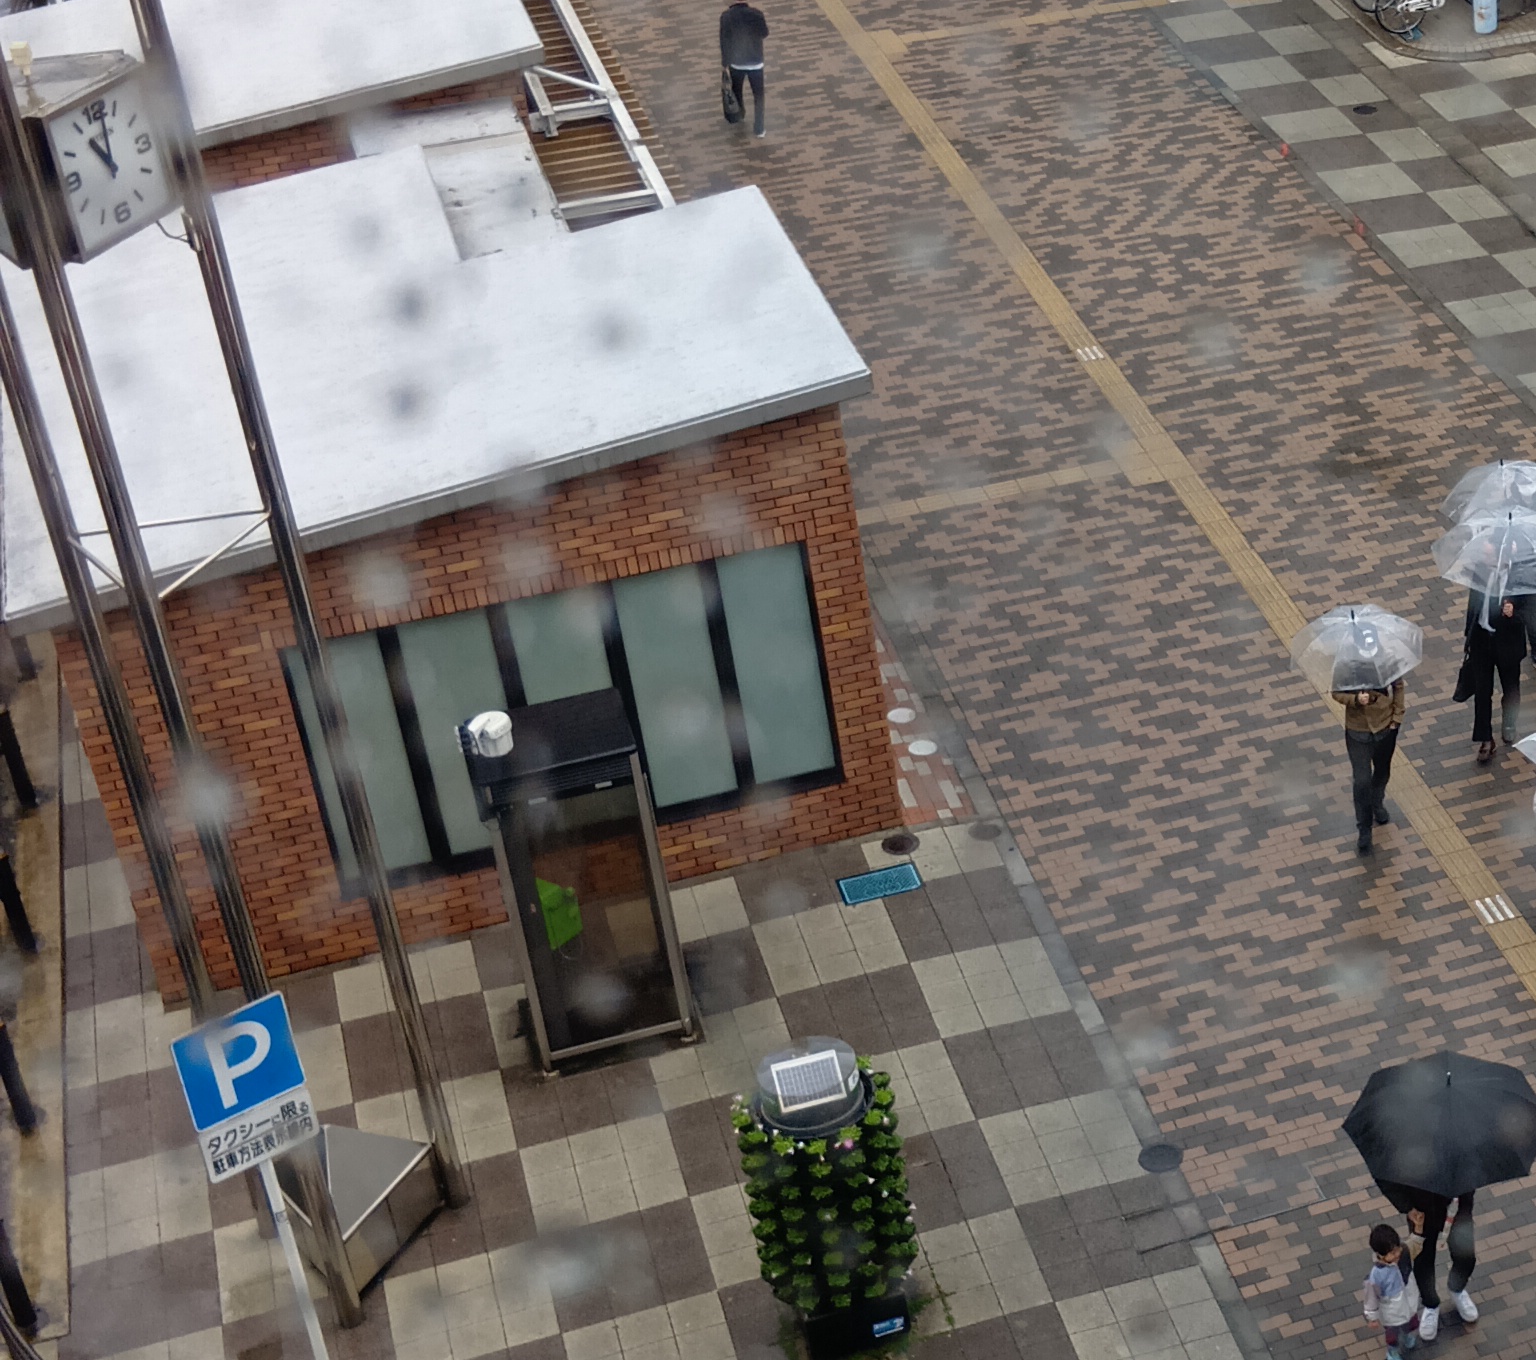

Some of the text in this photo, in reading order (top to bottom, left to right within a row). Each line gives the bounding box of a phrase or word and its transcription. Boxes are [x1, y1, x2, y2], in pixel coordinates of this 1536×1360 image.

[82, 99, 107, 126] 12
[134, 132, 152, 155] 3
[65, 171, 83, 194] 9
[113, 200, 132, 224] 6
[204, 1020, 271, 1110] P
[207, 1100, 309, 1155] タクシーに限る
